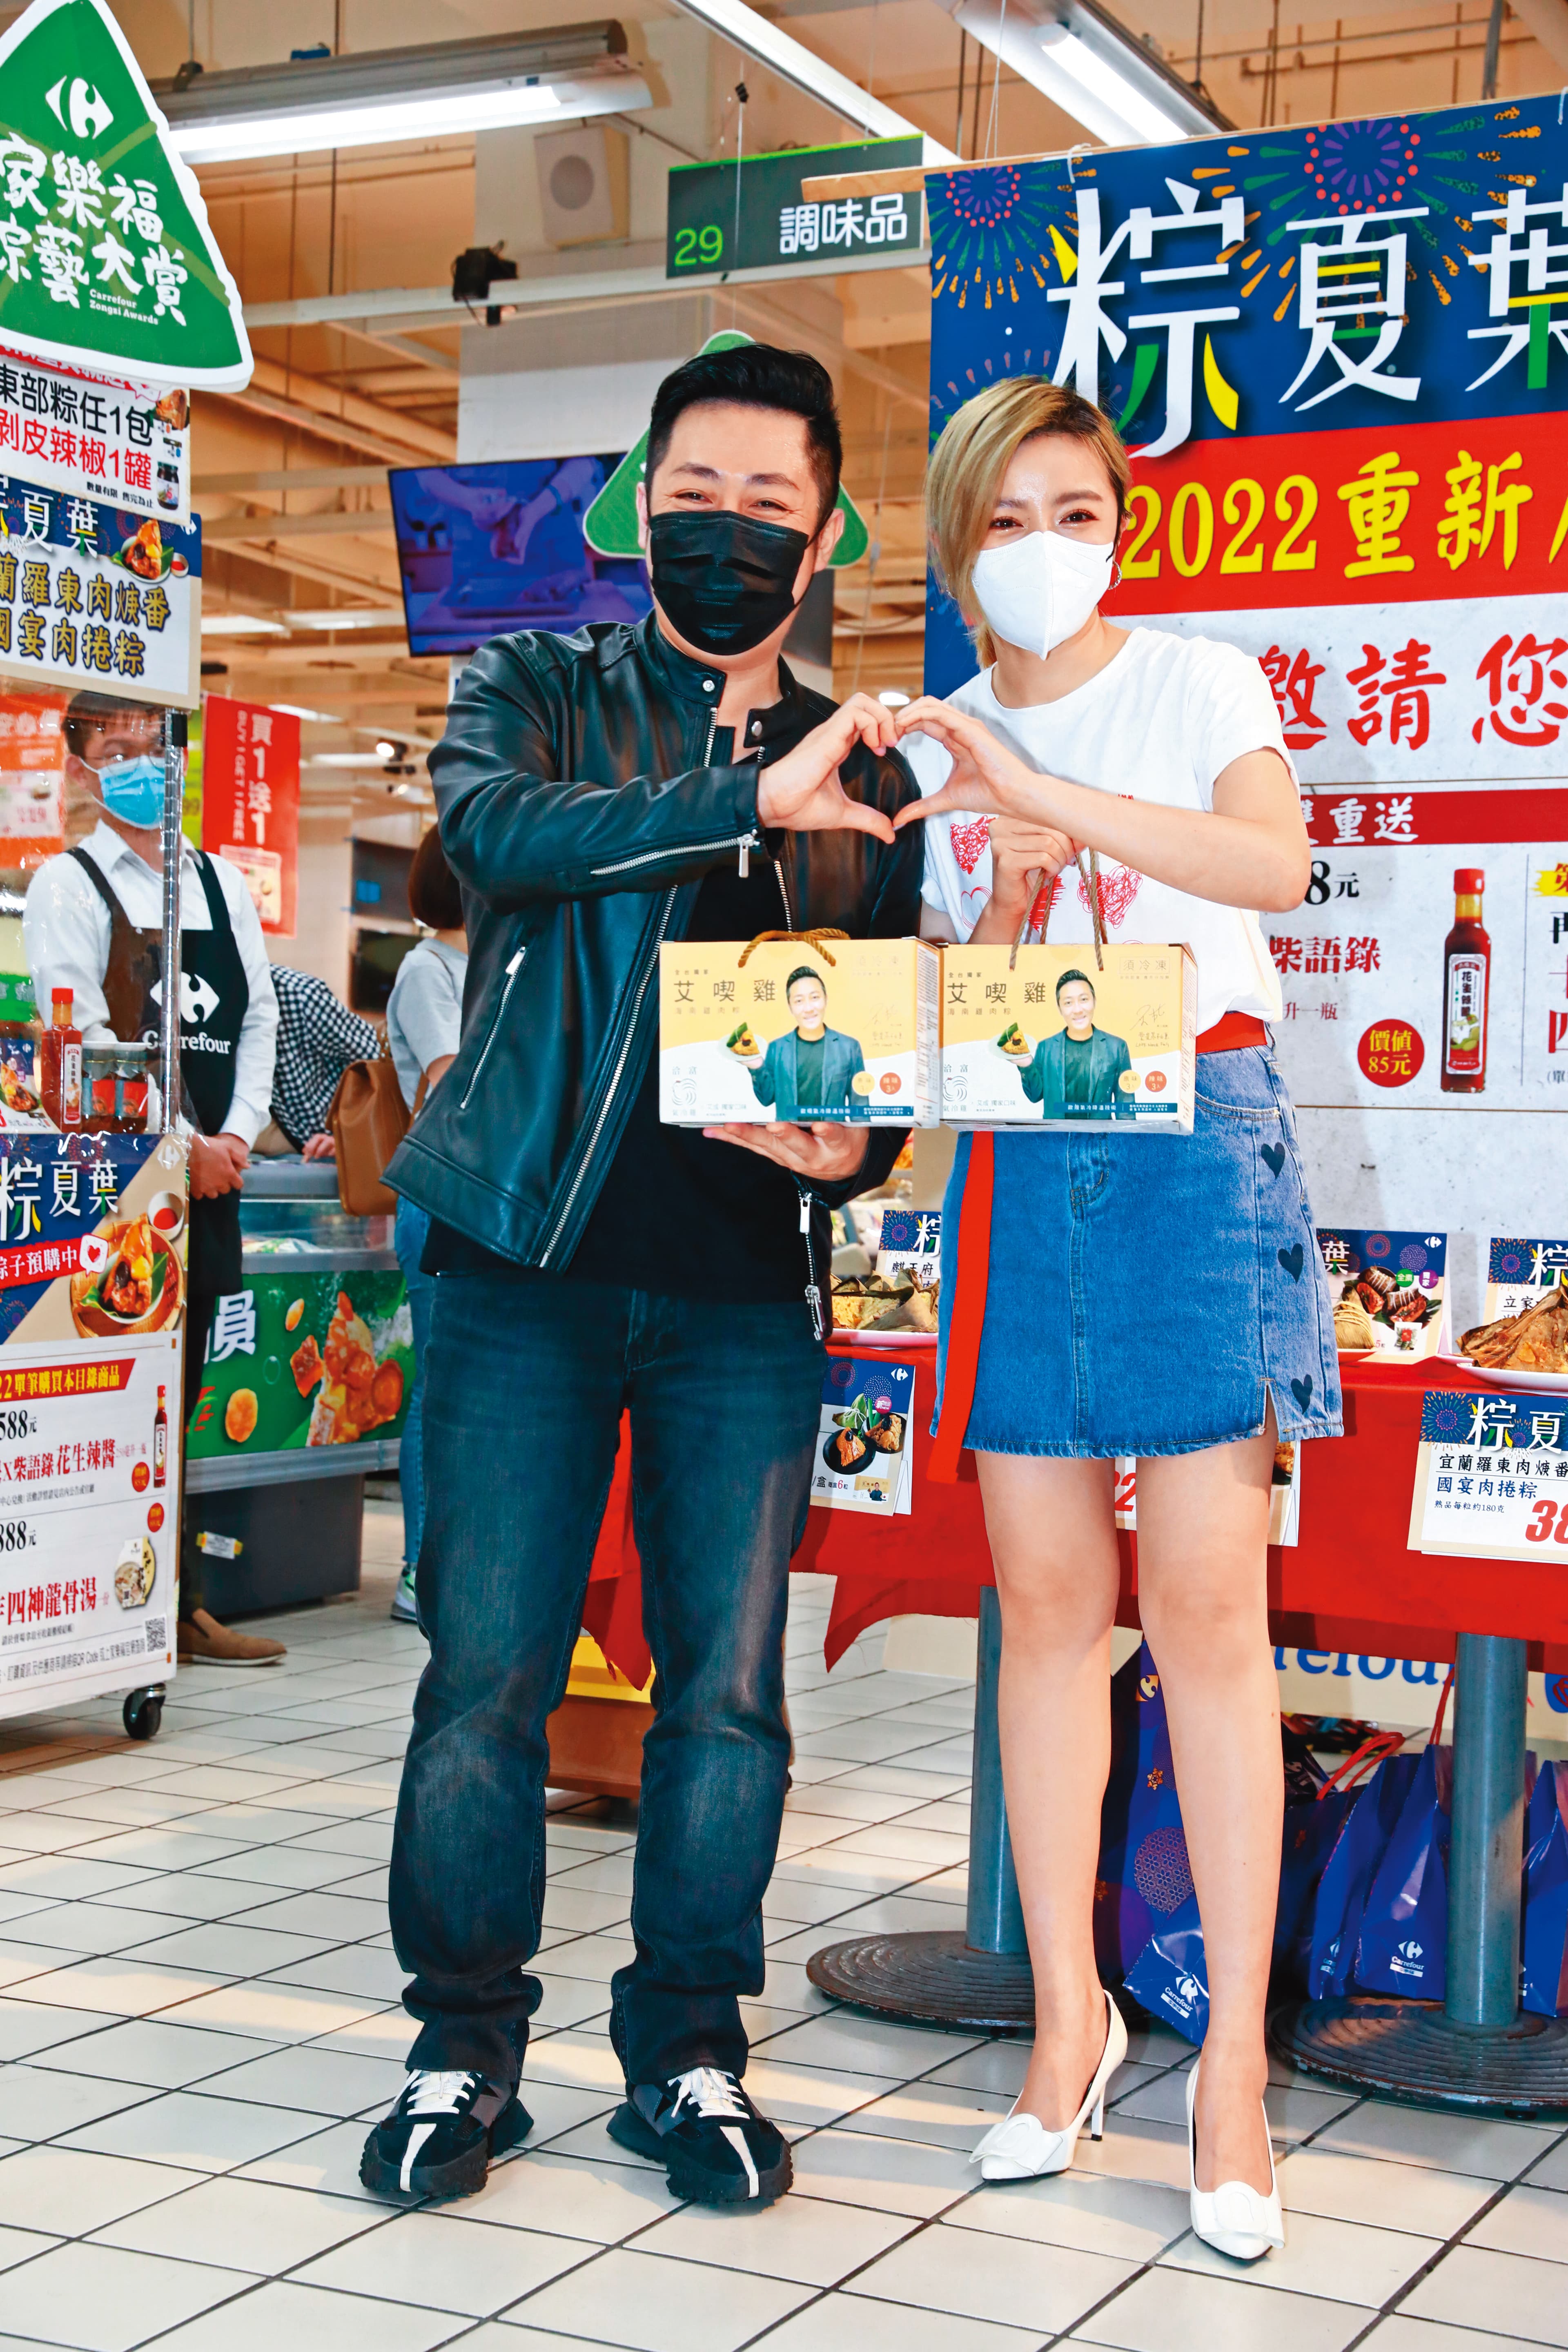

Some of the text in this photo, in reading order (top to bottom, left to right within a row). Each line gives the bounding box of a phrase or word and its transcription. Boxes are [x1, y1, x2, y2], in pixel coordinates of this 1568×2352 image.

[0, 132, 163, 243] 家樂福
[780, 193, 908, 254] 調味品
[675, 225, 723, 266] 29
[89, 288, 137, 308] Carrefour
[123, 309, 158, 325] Awards
[1046, 177, 1568, 459] 粽夏葉
[0, 363, 152, 446] 東部粽任1包
[87, 482, 118, 499] 數量有限
[0, 476, 98, 558] 夏葉
[1123, 960, 1167, 971] 須冷凍
[674, 980, 776, 1002] 艾喫雞
[947, 982, 1046, 1004] 艾喫雞
[142, 1029, 231, 1054] Crefour
[1369, 1029, 1412, 1053] 價值
[1368, 1054, 1411, 1076] 85元
[1322, 1240, 1350, 1275] 葉
[1503, 1295, 1539, 1309] 立家
[0, 1365, 120, 1399] 2單筆購買本目錄商品
[1466, 1397, 1566, 1454] 粽夏
[1114, 1470, 1136, 1512] 2
[1437, 1476, 1538, 1499] 國宴肉捲粽
[0, 1576, 96, 1626] 四神龍骨湯
[1391, 1956, 1425, 1970] Carrefour
[1165, 1987, 1194, 2012] Carrefour
